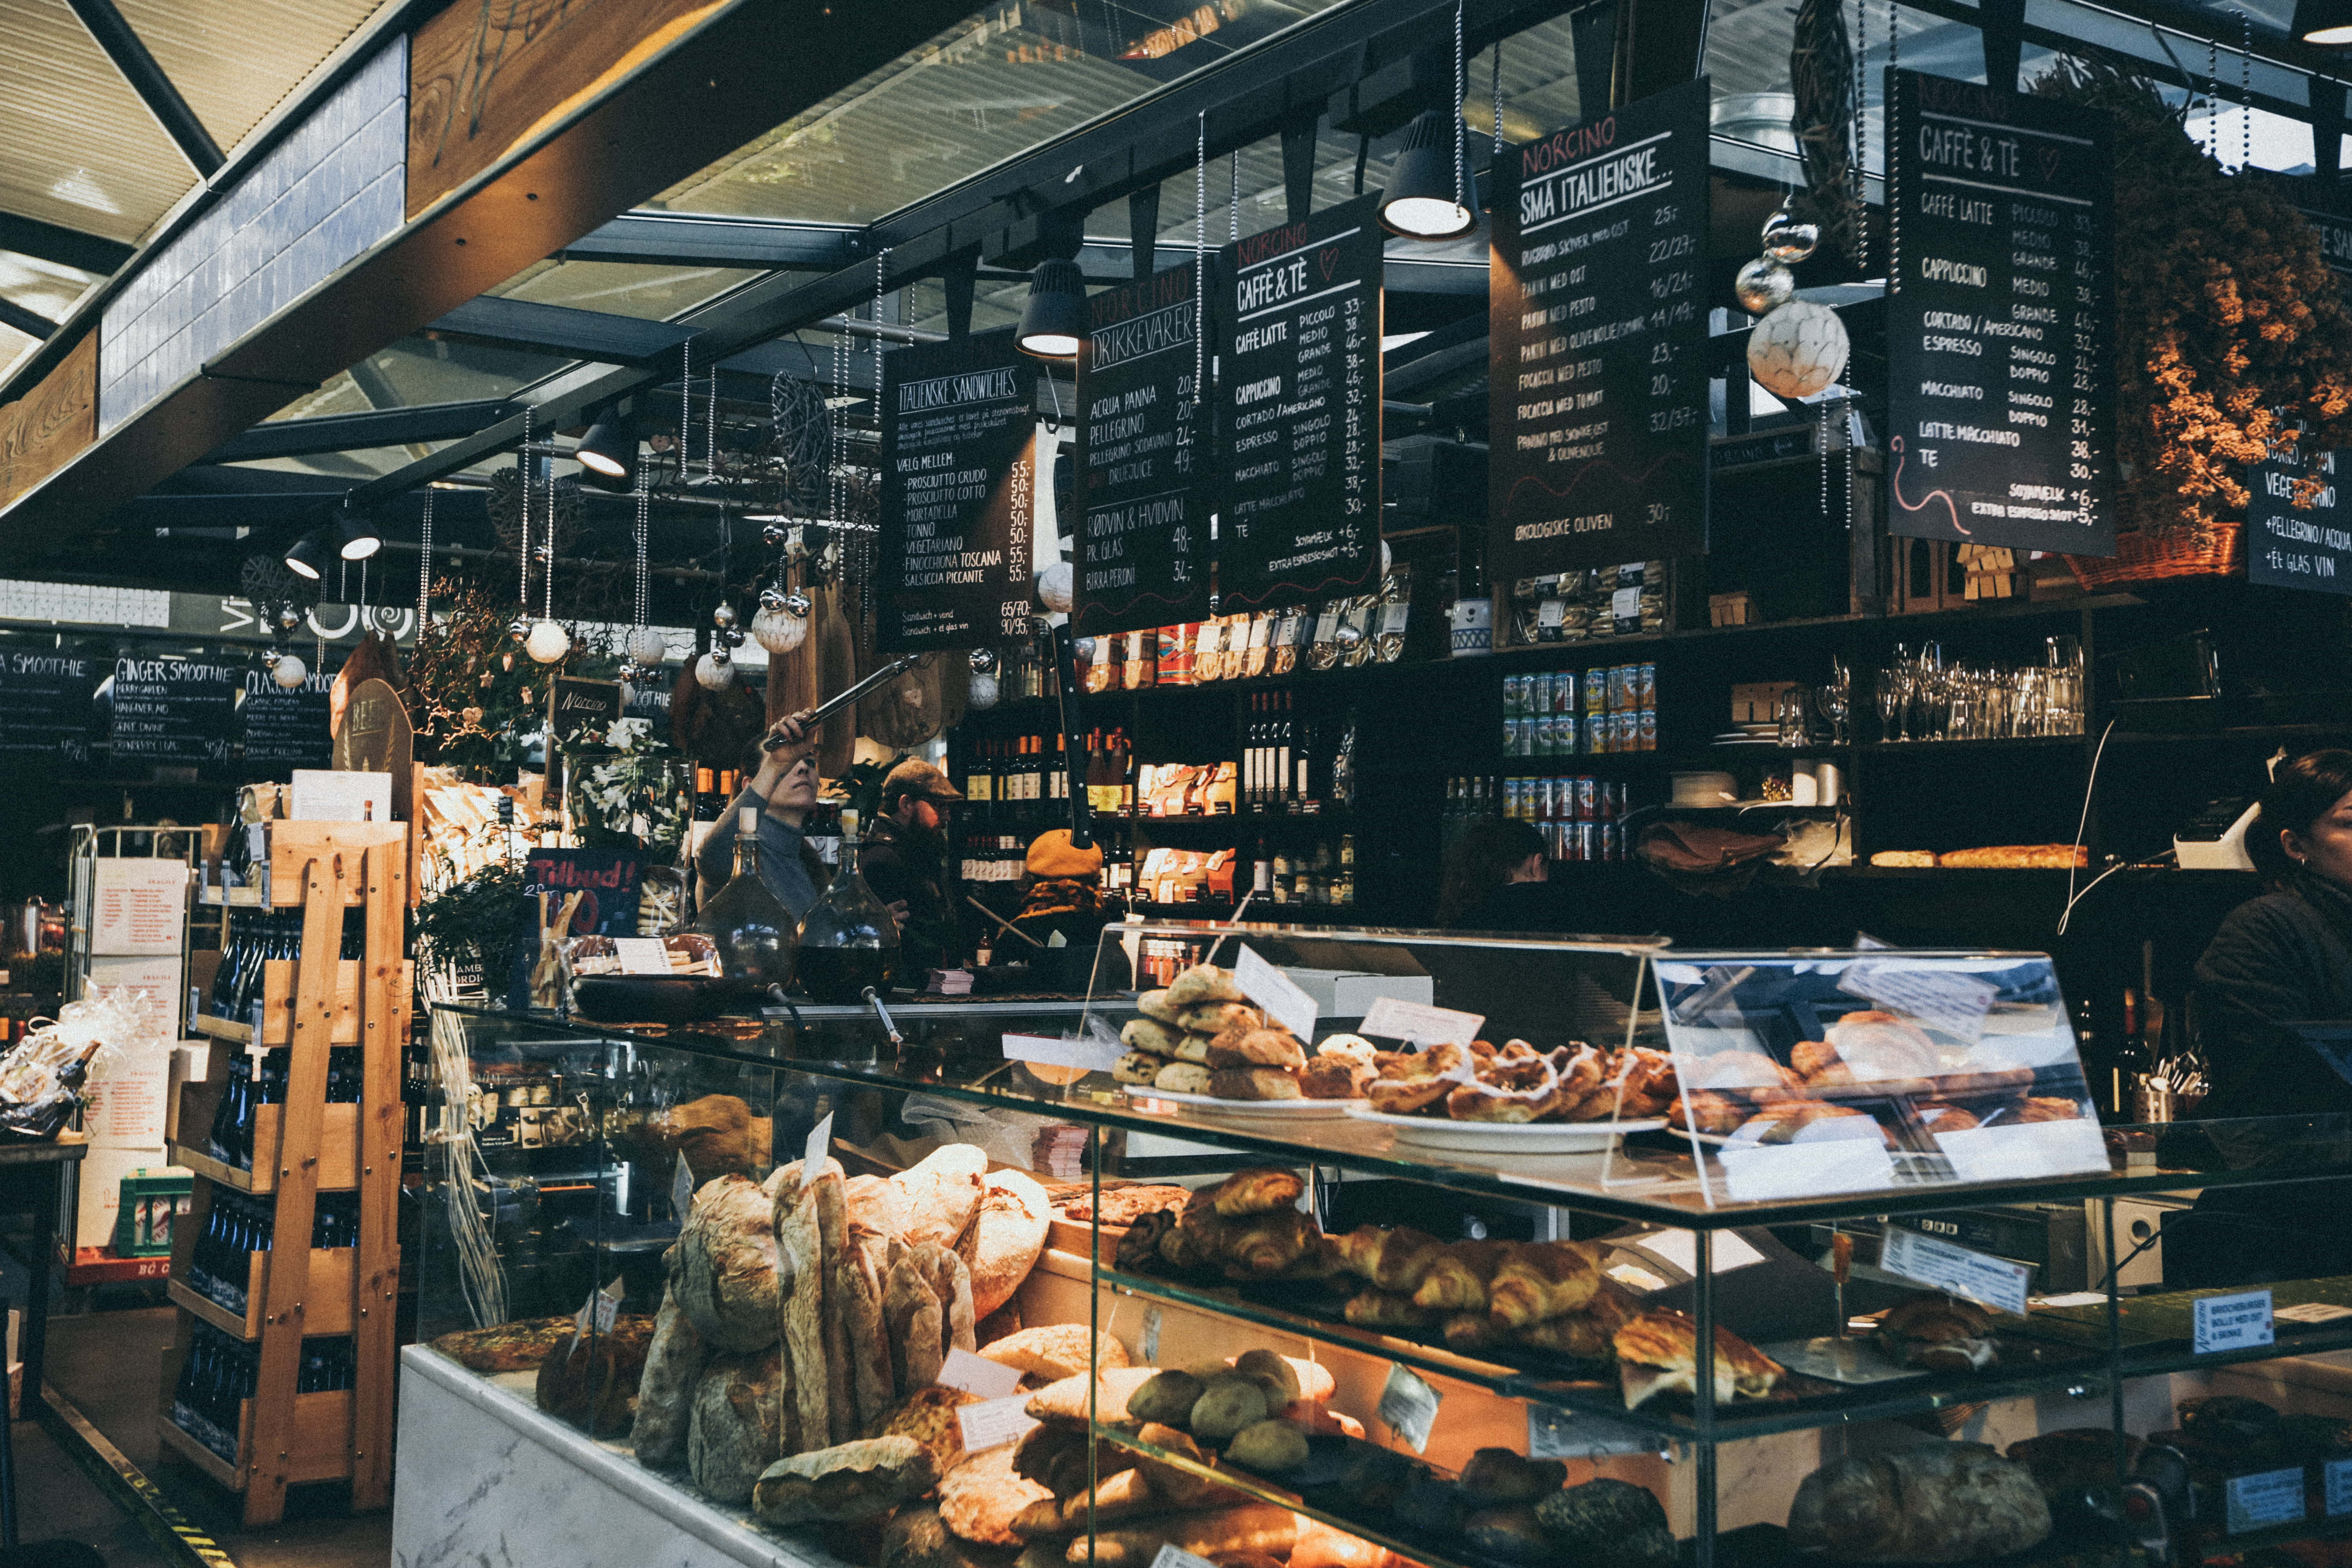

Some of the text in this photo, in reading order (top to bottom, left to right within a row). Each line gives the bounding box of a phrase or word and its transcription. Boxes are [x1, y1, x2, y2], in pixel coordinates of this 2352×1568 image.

[1523, 117, 1615, 177] NORCINO
[1919, 124, 1975, 169] CAFFÈ
[1980, 136, 1994, 172] &
[1520, 180, 1554, 225] SMÅ
[1960, 198, 1993, 226] LATTE
[1238, 223, 1306, 268] NORCINO
[1550, 272, 1567, 291] MED
[1570, 265, 1586, 285] OST
[1922, 257, 1986, 287] CAPPUCCINO
[1092, 268, 1188, 329] NORCINO
[1238, 267, 1274, 312] CAFFÈ
[1276, 268, 1287, 299] &
[1092, 305, 1193, 370] DRIKKEVARER
[1237, 306, 1335, 354] CAFFÈ LATTE PICCOLO
[1300, 327, 1327, 345] MEDIO
[1298, 343, 1331, 363] GRANDE
[1923, 336, 2056, 365] ESPRESSO SINGOLO
[1236, 365, 1323, 405] CAPPUCCINO MEDIO
[2010, 365, 2049, 383] DOPPIO
[899, 369, 1016, 411] ITALIENSKE SANDWICHES
[1090, 385, 1156, 420] ACQUA PANNA
[2008, 391, 2053, 408] SINGOLO
[1236, 408, 1275, 429] CORTADO
[1282, 396, 1325, 416] AMERICANO
[2009, 410, 2047, 427] DOPPIO
[1090, 413, 1144, 446] PELLEGRINO
[1236, 414, 1331, 452] ESPRESSO SINGOLO
[1294, 432, 1326, 451] DOPPIO
[1919, 421, 1955, 440] LATTE
[1090, 443, 1131, 466] PELLEGRINO
[1135, 432, 1172, 454] SODAVAND
[1919, 449, 1938, 467] TE
[896, 457, 918, 472] VÆLG
[1109, 459, 1152, 485] DRUEJUICE
[1235, 461, 1279, 482] MACCHIATO
[1292, 449, 1328, 470] SINGOLO
[907, 473, 955, 490] PROSCIUTTO
[958, 469, 986, 483] CRUDO
[907, 488, 954, 506] PROSCIUTTO
[958, 484, 985, 500] COTTO
[1235, 499, 1257, 515] LATTE
[907, 504, 957, 522] MORTADELLA
[1088, 509, 1124, 538] RØDVIN
[1127, 507, 1134, 530] &
[1139, 496, 1183, 527] HVIDVIN
[907, 522, 935, 538] TONNO
[1515, 513, 1613, 541] ØKOLOGISKE OLIVEN
[906, 536, 963, 554] VEGETARIANO
[1102, 538, 1122, 560] GLAS
[2325, 528, 2352, 552] ACQUA
[905, 554, 958, 571] FINOCCHIONA
[960, 550, 1001, 567] TOSCANA
[1269, 556, 1292, 572] EXTRA
[2287, 553, 2310, 574] GLAS
[2315, 555, 2334, 577] VIN
[905, 572, 944, 587] SALSICCIA
[946, 569, 984, 584] PICCANTE
[1087, 568, 1108, 591] BIRRA
[1110, 563, 1135, 588] PERONI
[946, 623, 957, 634] glas
[13, 653, 87, 677] SMOOTHIE
[116, 658, 234, 683] GINGER SMOOTHIE
[562, 692, 606, 710] Norcino
[531, 859, 636, 892] Tilbud!
